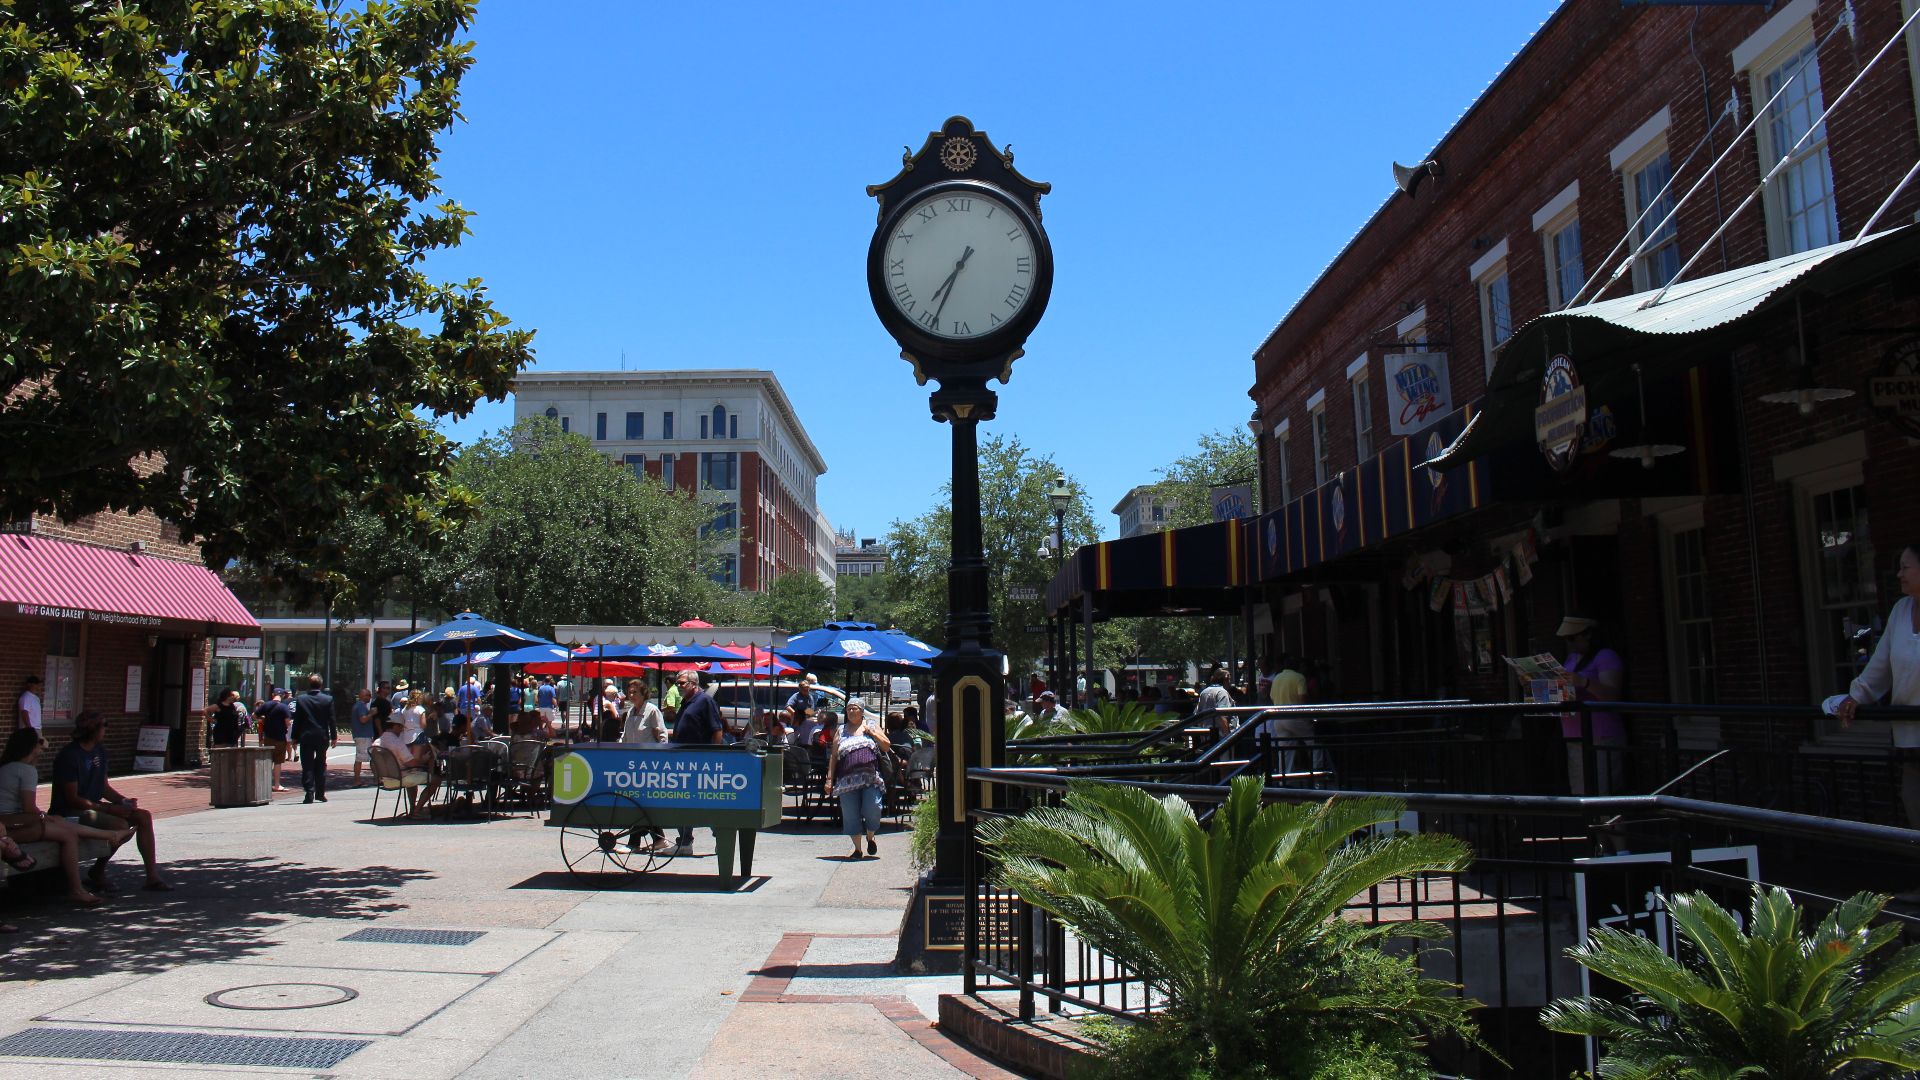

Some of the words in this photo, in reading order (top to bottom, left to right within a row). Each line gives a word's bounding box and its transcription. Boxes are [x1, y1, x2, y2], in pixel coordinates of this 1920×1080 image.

[946, 199, 972, 212] XII
[985, 206, 996, 219] I
[918, 205, 939, 224] XI
[897, 228, 914, 244] X
[1006, 227, 1022, 243] II
[891, 258, 905, 277] IX
[1017, 255, 1030, 274] III
[989, 312, 1002, 327] V
[953, 321, 972, 335] VI
[1394, 364, 1437, 390] WILD
[40, 606, 60, 618] GANG
[61, 608, 85, 620] BAKERY
[88, 611, 100, 621] Your
[139, 616, 148, 625] Pet
[148, 617, 162, 626] Store
[628, 760, 724, 772] SAVANNAH
[603, 771, 692, 789] TOURIST
[697, 773, 748, 790] INFO
[647, 790, 691, 800] LODGING
[697, 791, 737, 801] TICKETS
